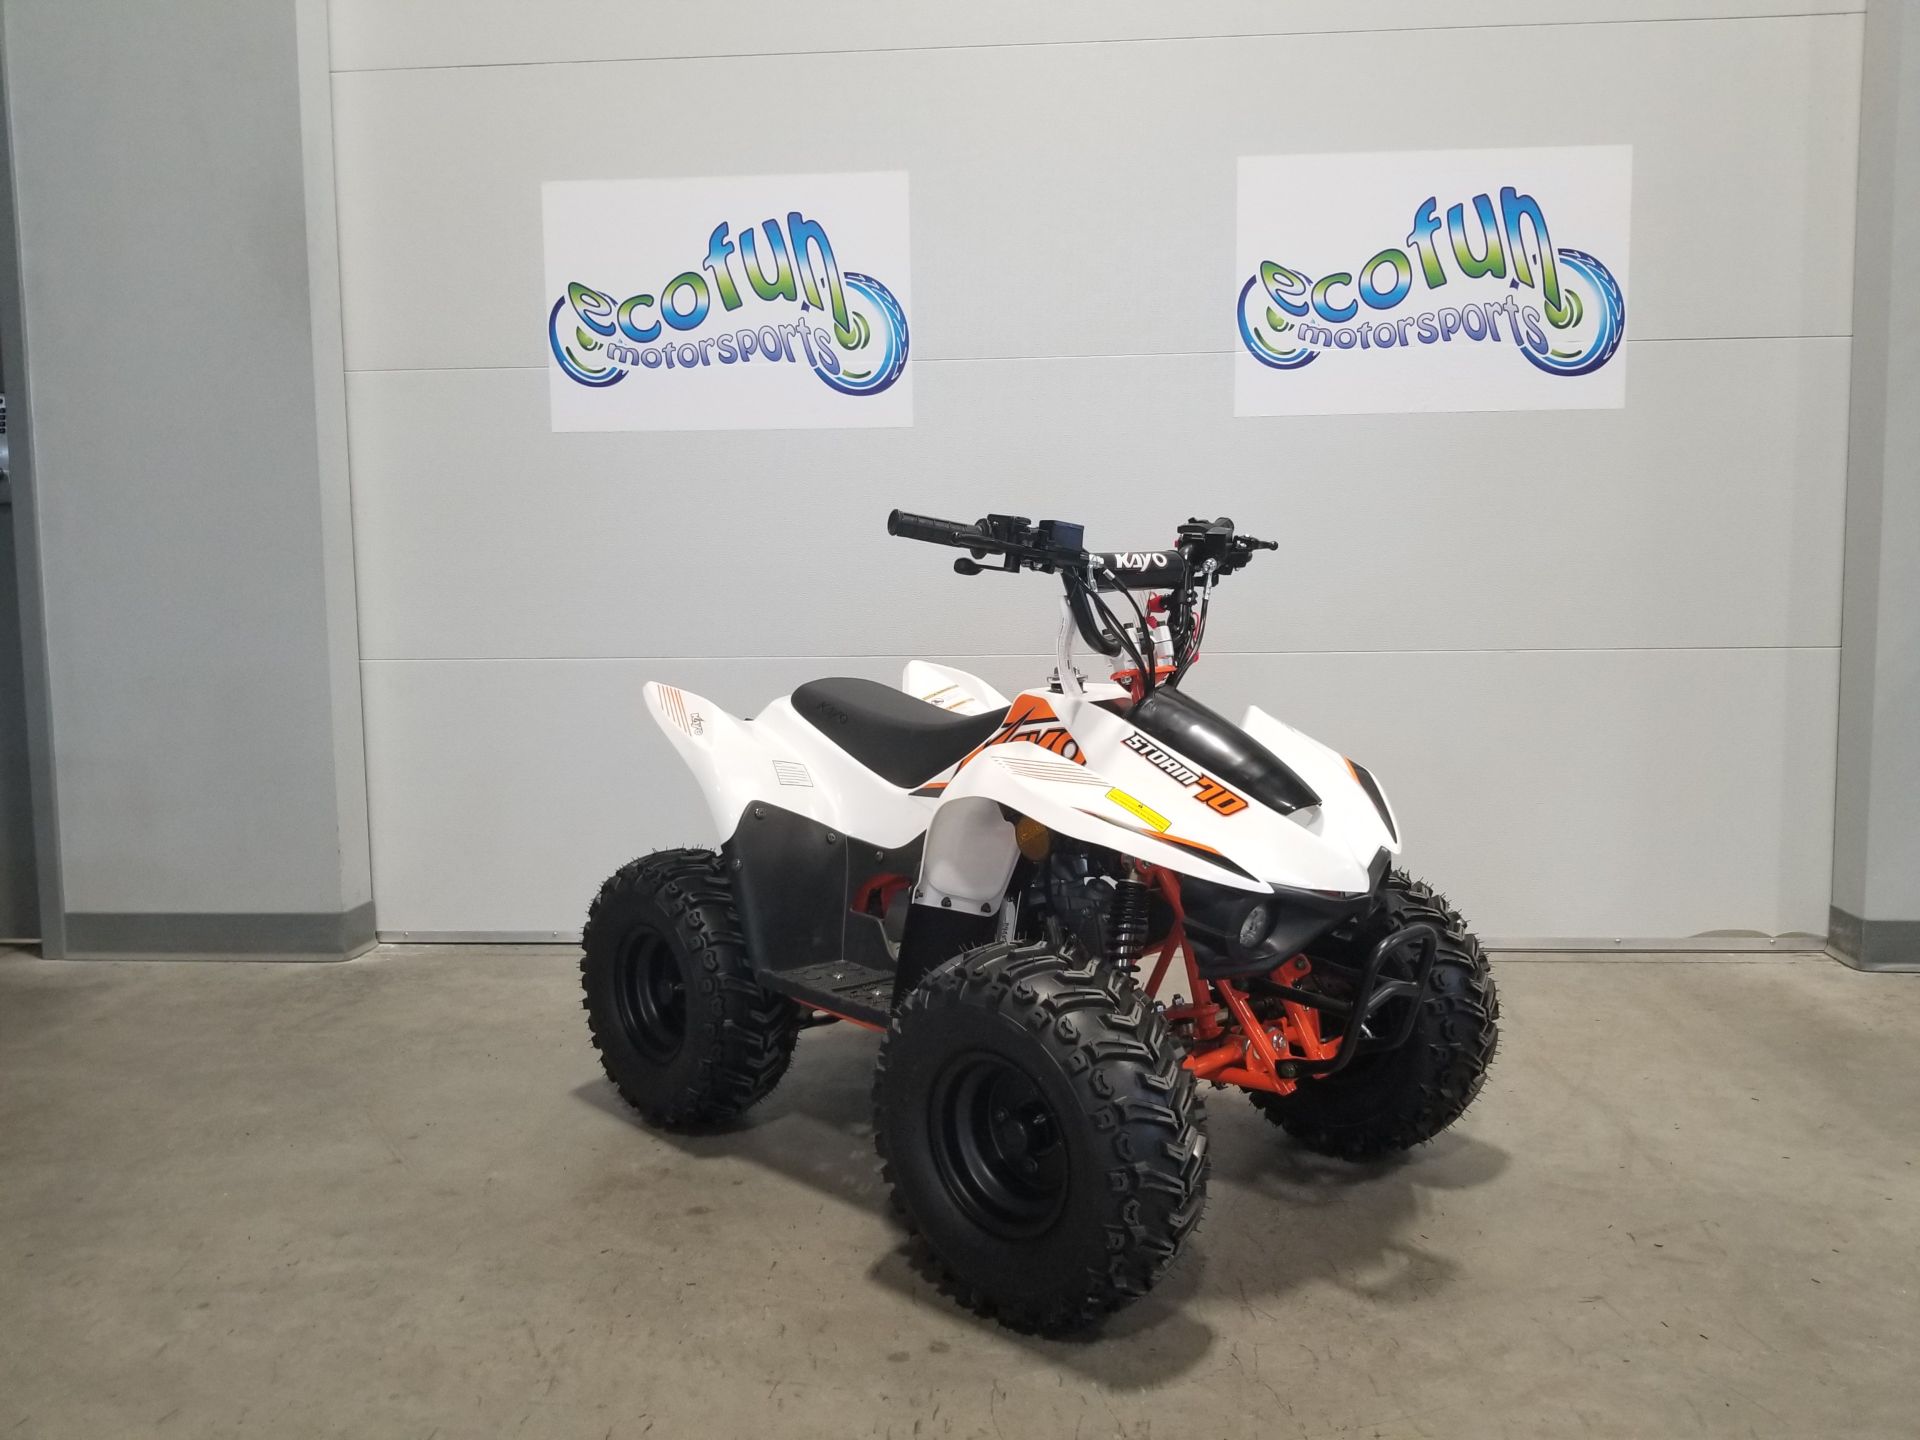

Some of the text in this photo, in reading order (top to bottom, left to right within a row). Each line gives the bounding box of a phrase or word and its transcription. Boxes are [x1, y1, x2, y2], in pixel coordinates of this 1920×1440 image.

[606, 316, 841, 376] motorsports
[1297, 294, 1550, 356] motorsports
[1120, 730, 1201, 788] STORM
[1192, 772, 1249, 817] 70
